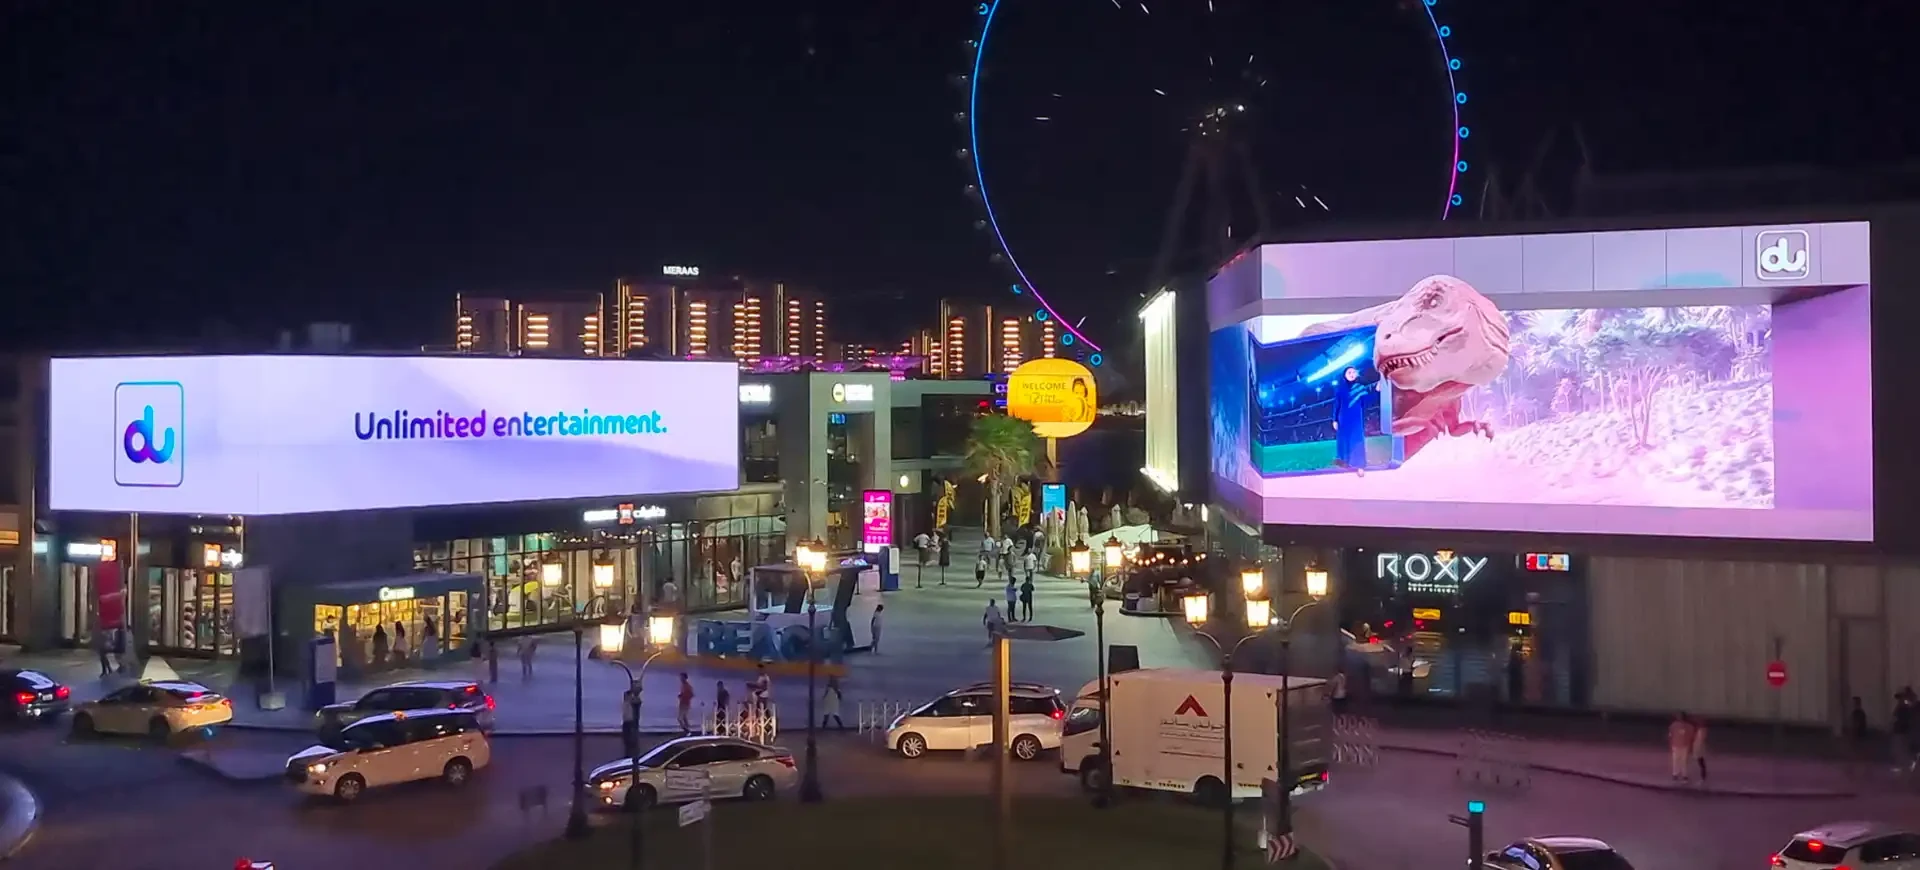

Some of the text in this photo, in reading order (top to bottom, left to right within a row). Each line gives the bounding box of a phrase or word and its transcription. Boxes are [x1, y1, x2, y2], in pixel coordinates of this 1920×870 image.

[1760, 237, 1806, 273] du
[1022, 382, 1067, 390] WELCOME
[124, 404, 174, 463] du
[354, 409, 667, 440] Unlimited entertainment.
[1377, 553, 1488, 582] ROXY
